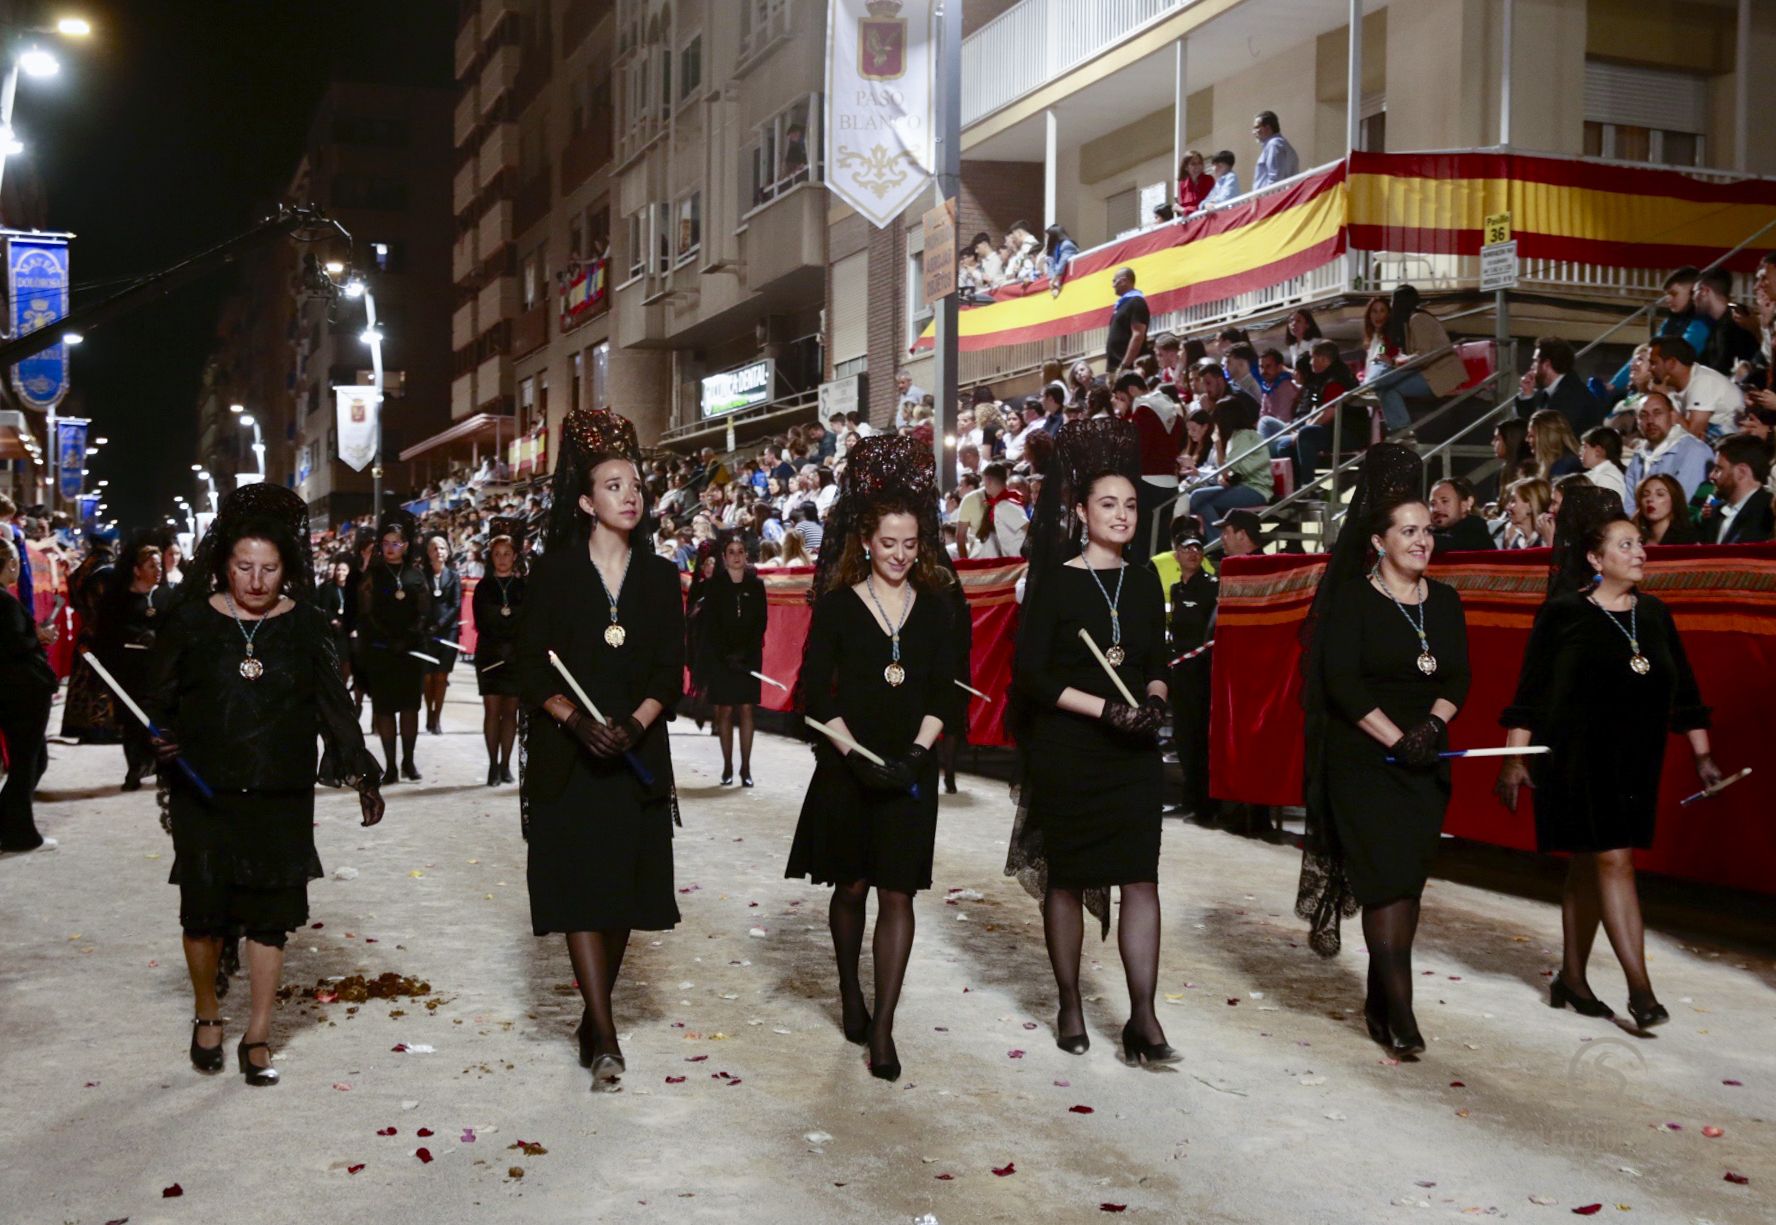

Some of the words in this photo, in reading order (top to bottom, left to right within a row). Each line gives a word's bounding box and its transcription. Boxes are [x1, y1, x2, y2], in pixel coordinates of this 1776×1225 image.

[856, 90, 904, 107] PASO
[839, 112, 921, 130] BLANO
[1490, 227, 1505, 243] 36
[739, 363, 767, 392] DENTAL
